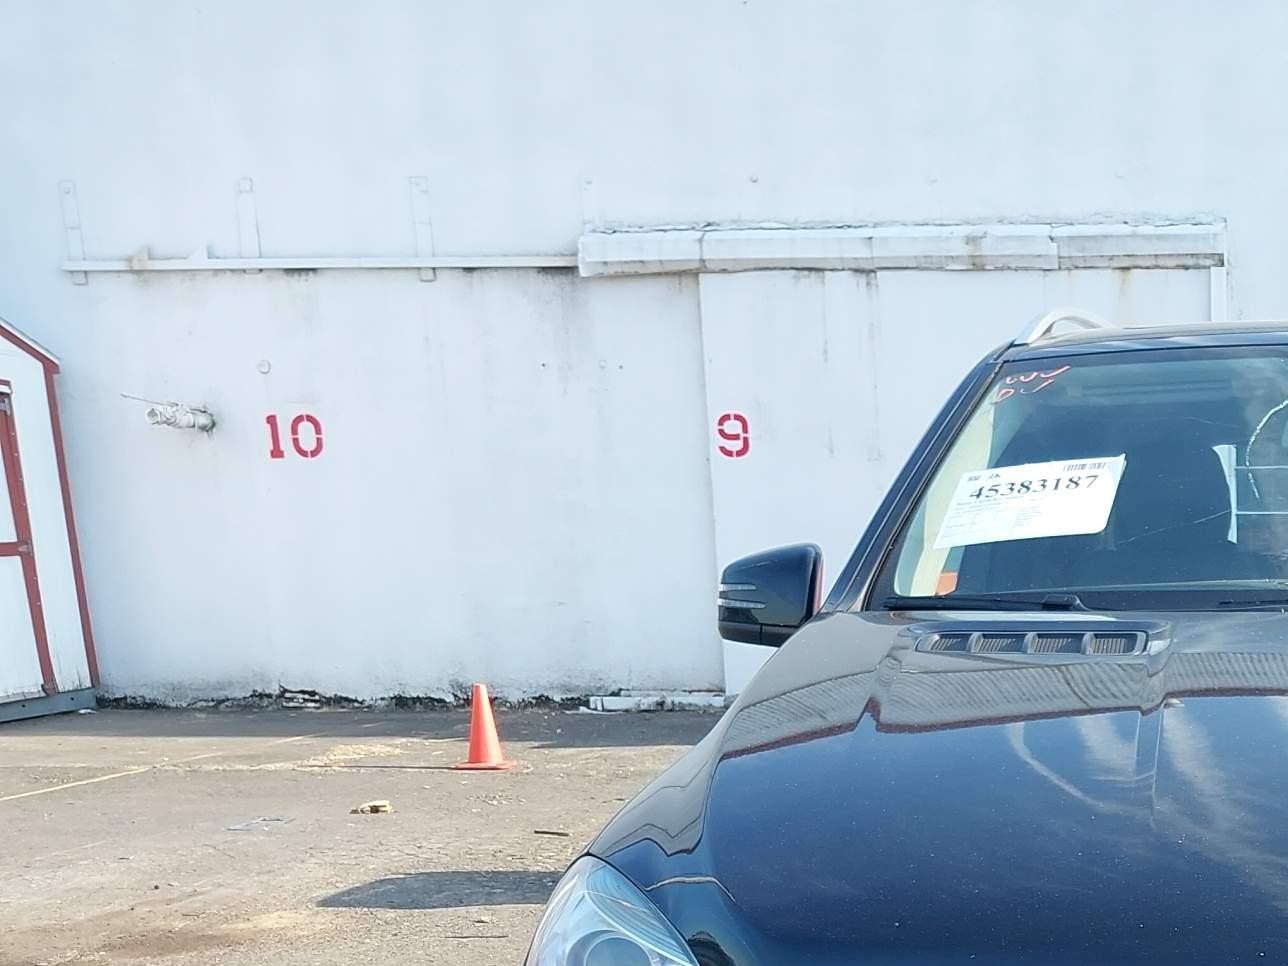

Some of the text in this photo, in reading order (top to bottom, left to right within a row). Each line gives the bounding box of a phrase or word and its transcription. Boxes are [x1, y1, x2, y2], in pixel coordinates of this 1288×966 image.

[265, 414, 323, 458] 10
[718, 413, 750, 458] 9
[969, 474, 1099, 500] 45383187
